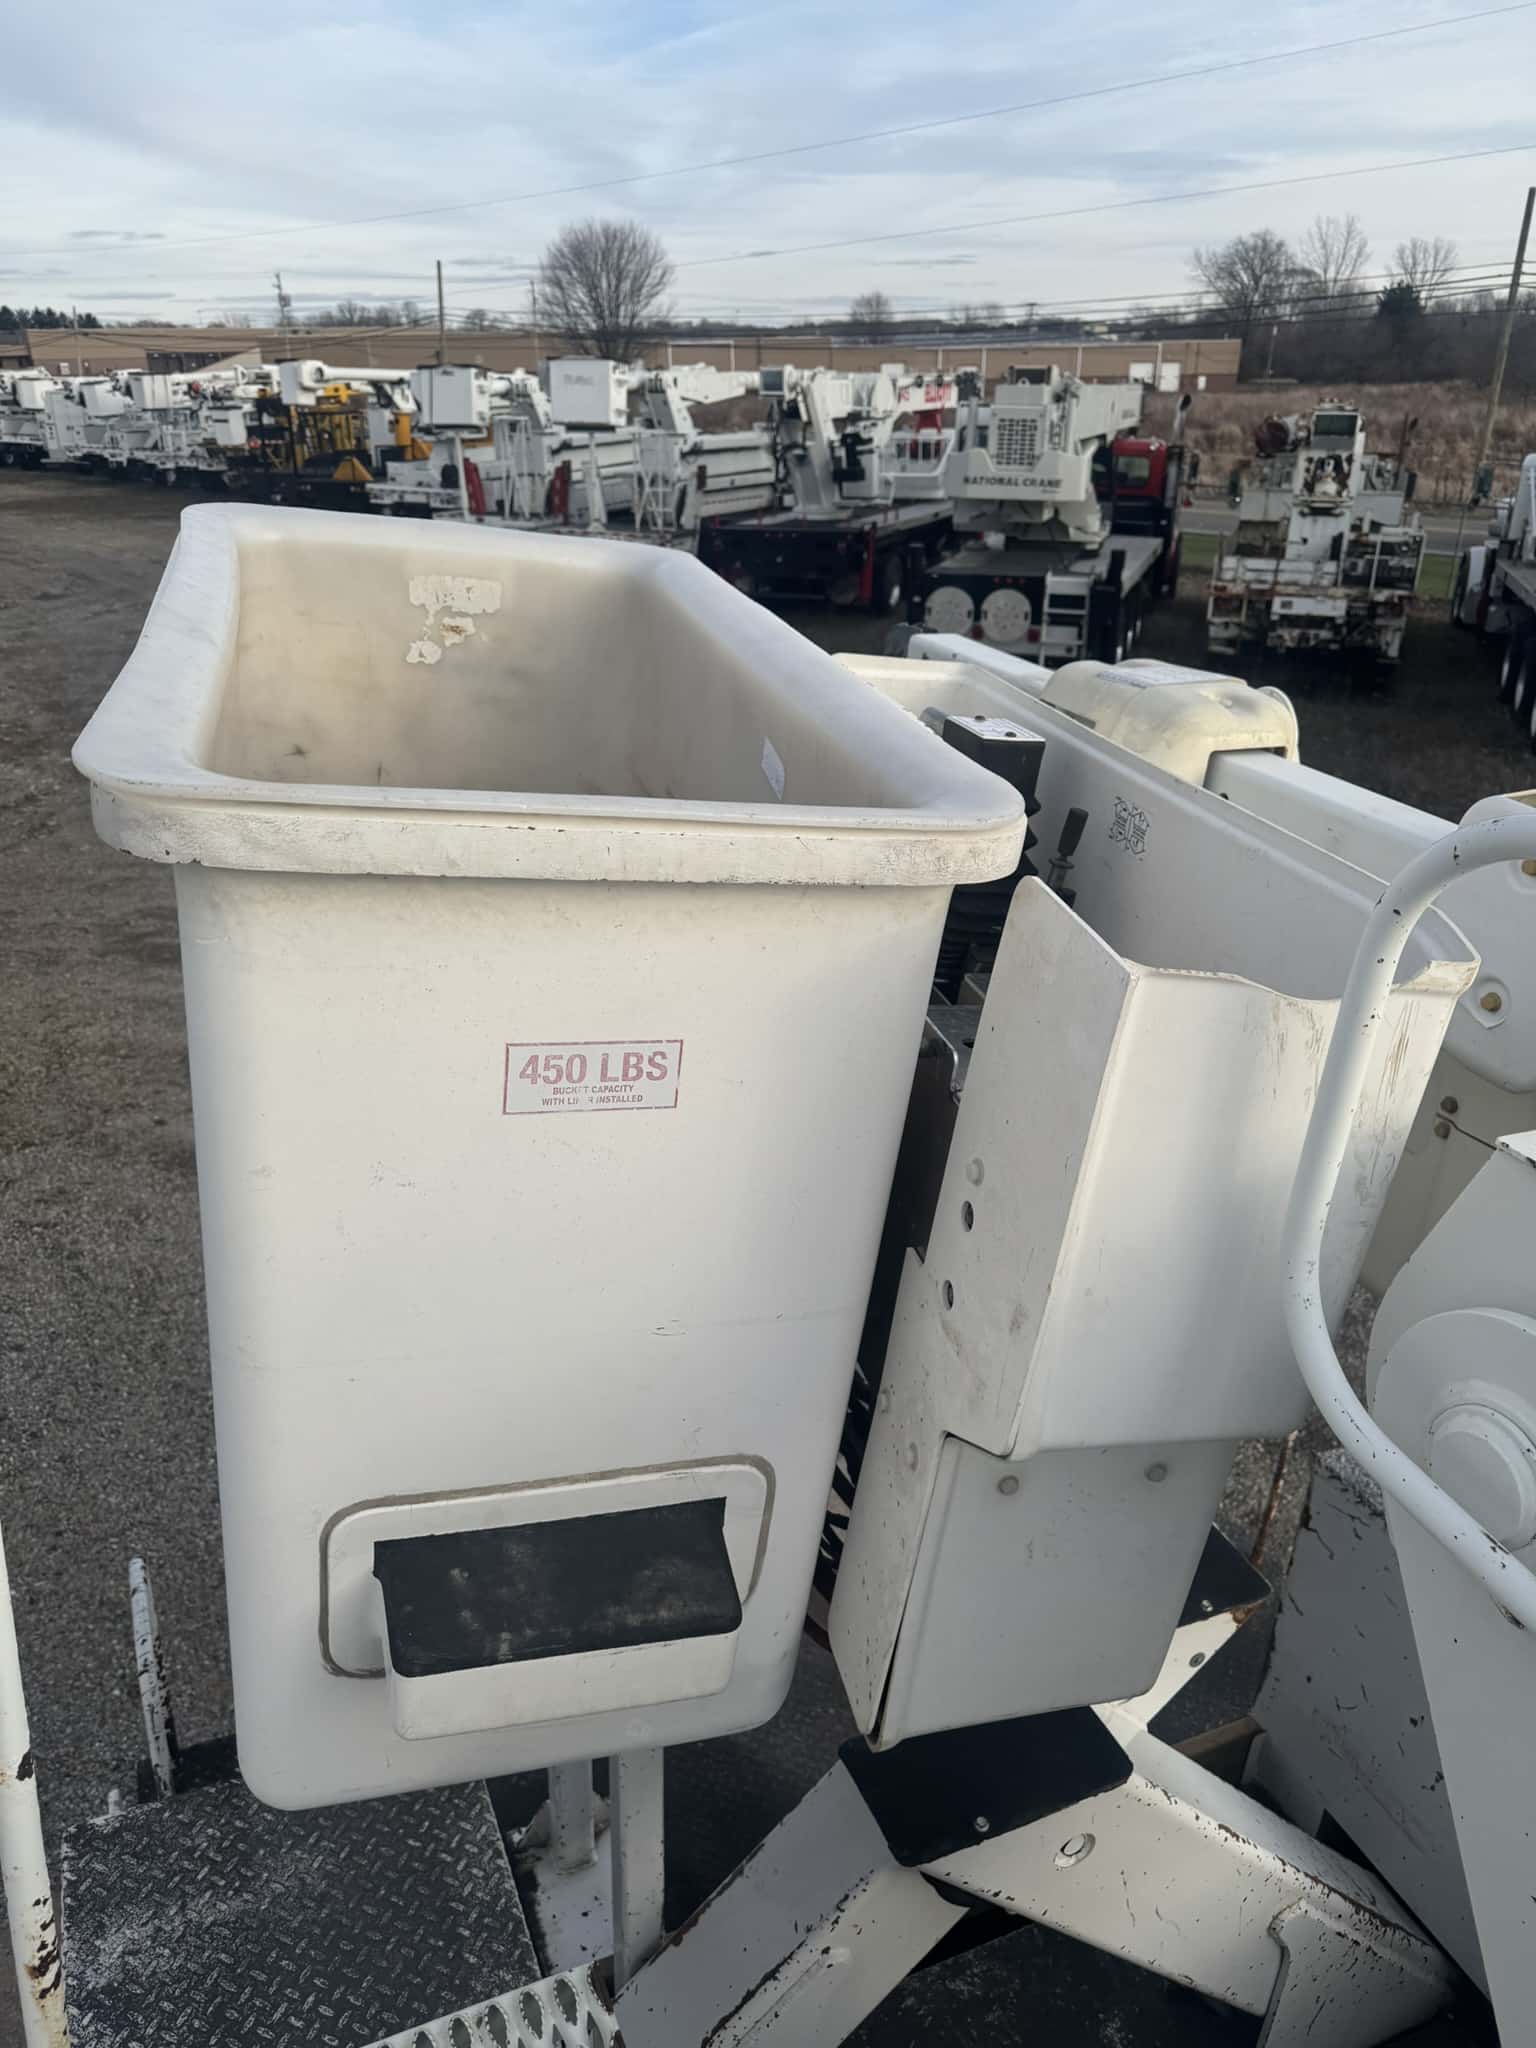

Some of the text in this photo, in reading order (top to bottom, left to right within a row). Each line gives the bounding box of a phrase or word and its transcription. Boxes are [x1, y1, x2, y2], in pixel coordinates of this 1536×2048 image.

[963, 476, 1062, 488] NATIONAL CRANE
[519, 1051, 668, 1084] 450 LBS
[553, 1085, 634, 1095] BUCKT CAPACITY
[542, 1097, 565, 1105] WITH
[596, 1094, 643, 1104] INSTALLED
